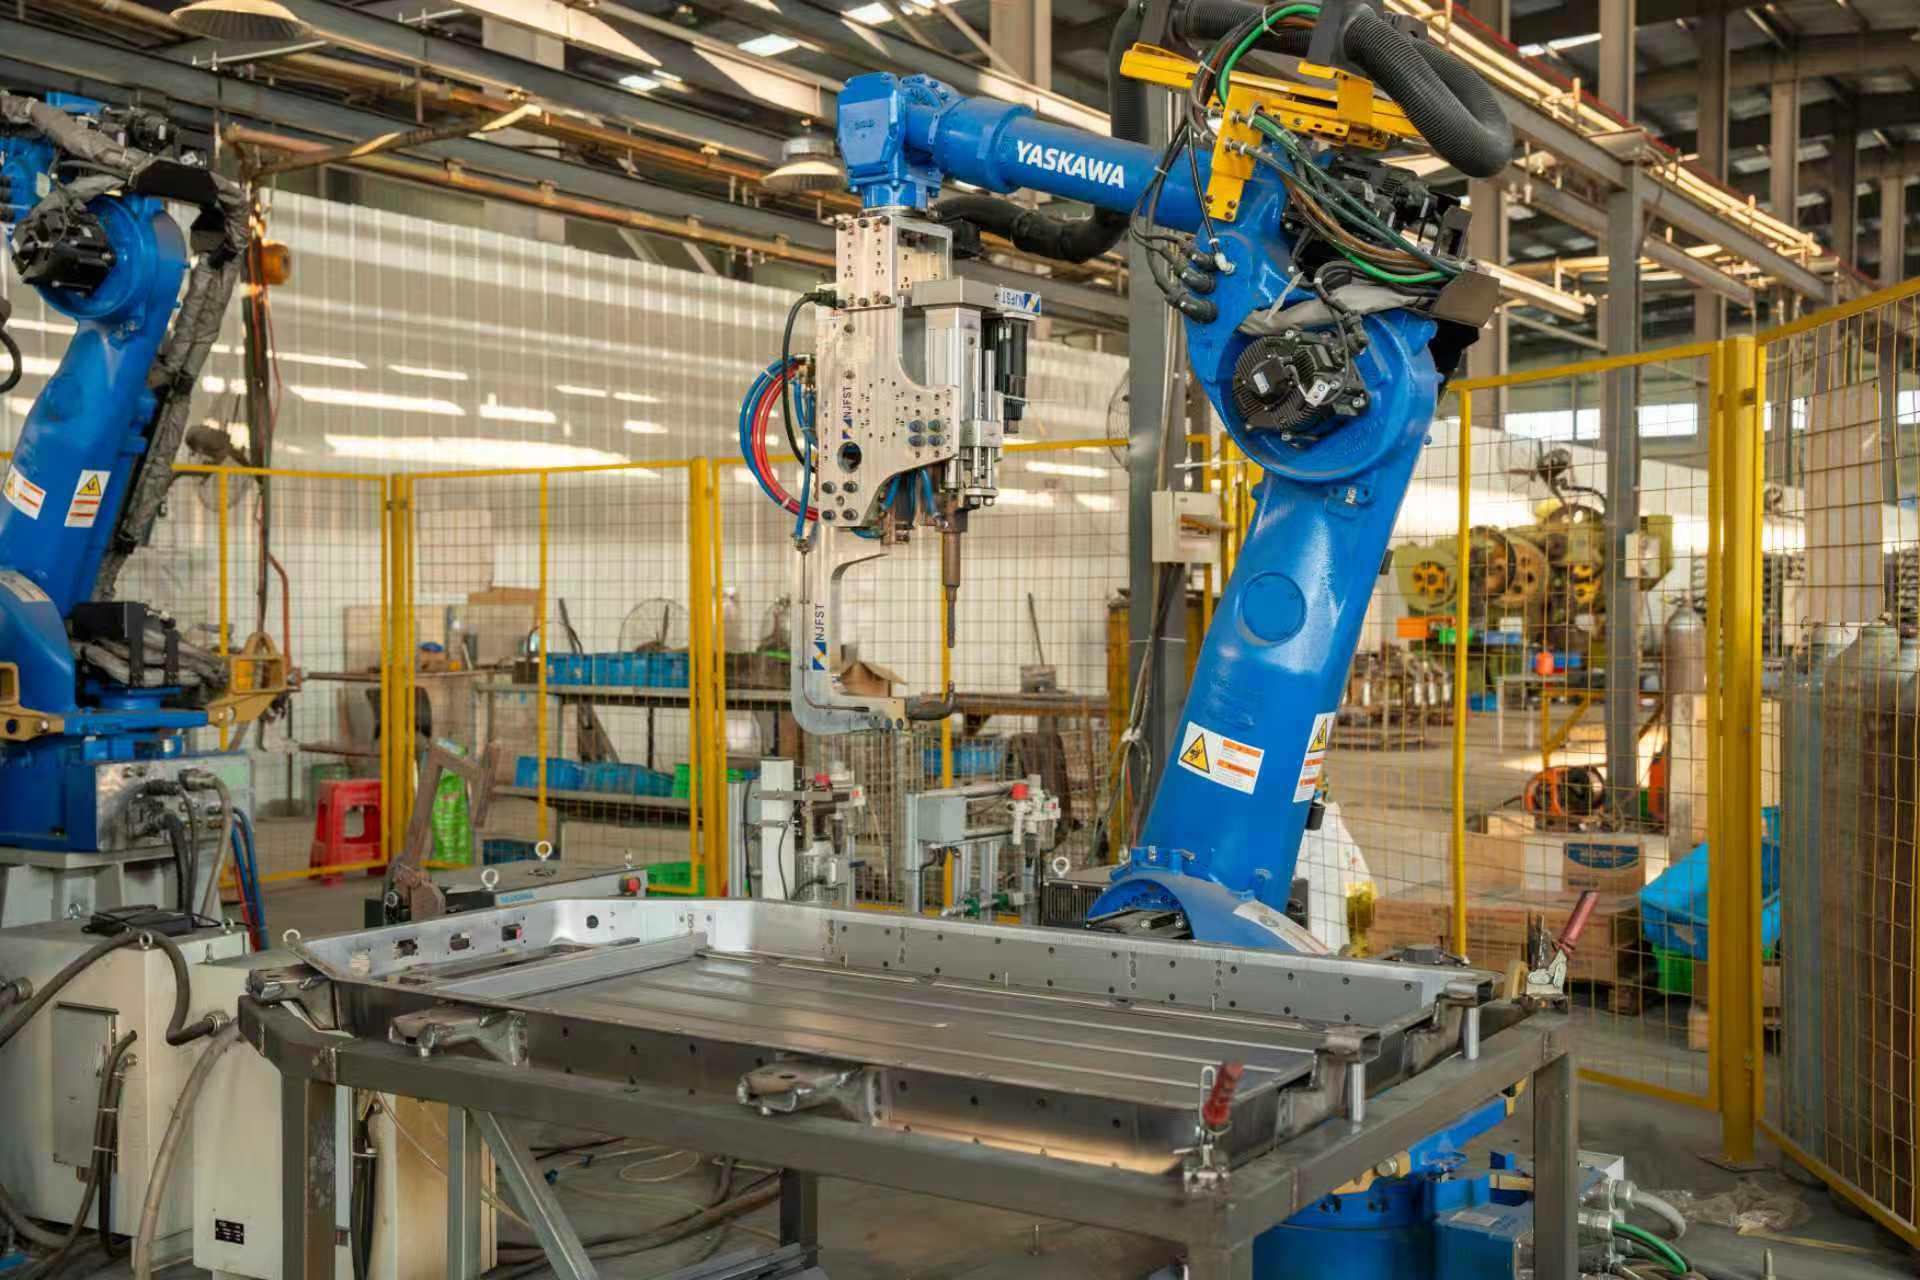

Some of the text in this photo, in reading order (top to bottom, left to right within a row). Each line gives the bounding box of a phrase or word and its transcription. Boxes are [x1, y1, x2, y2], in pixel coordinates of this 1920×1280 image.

[1017, 140, 1124, 189] YASKAWA
[842, 385, 852, 417] NJFST
[815, 603, 825, 641] NJFST
